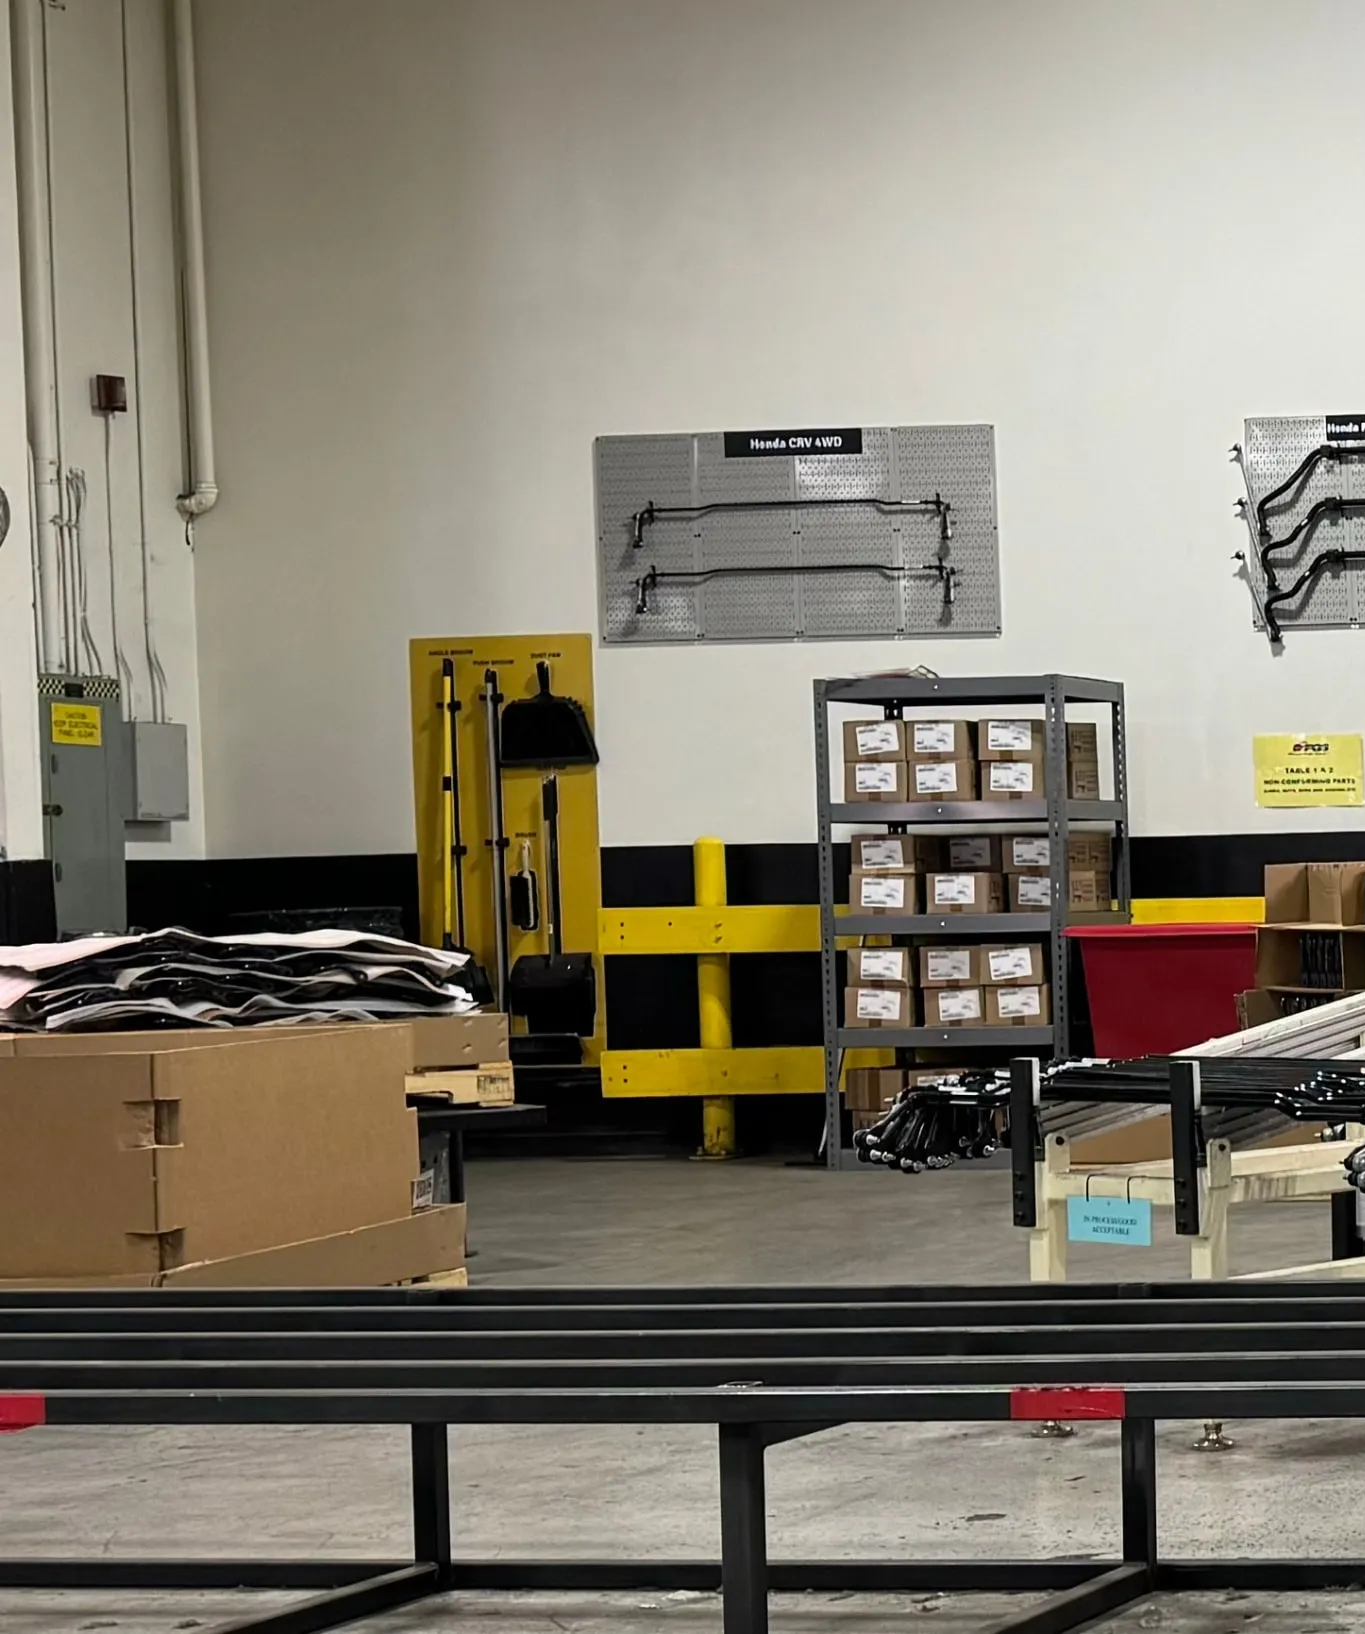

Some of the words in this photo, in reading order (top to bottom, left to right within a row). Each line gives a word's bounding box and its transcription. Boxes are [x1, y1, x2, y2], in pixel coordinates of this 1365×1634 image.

[1327, 421, 1359, 434] Honda
[749, 438, 786, 450] Honda
[788, 437, 812, 448] CRV
[814, 435, 843, 448] 4WD
